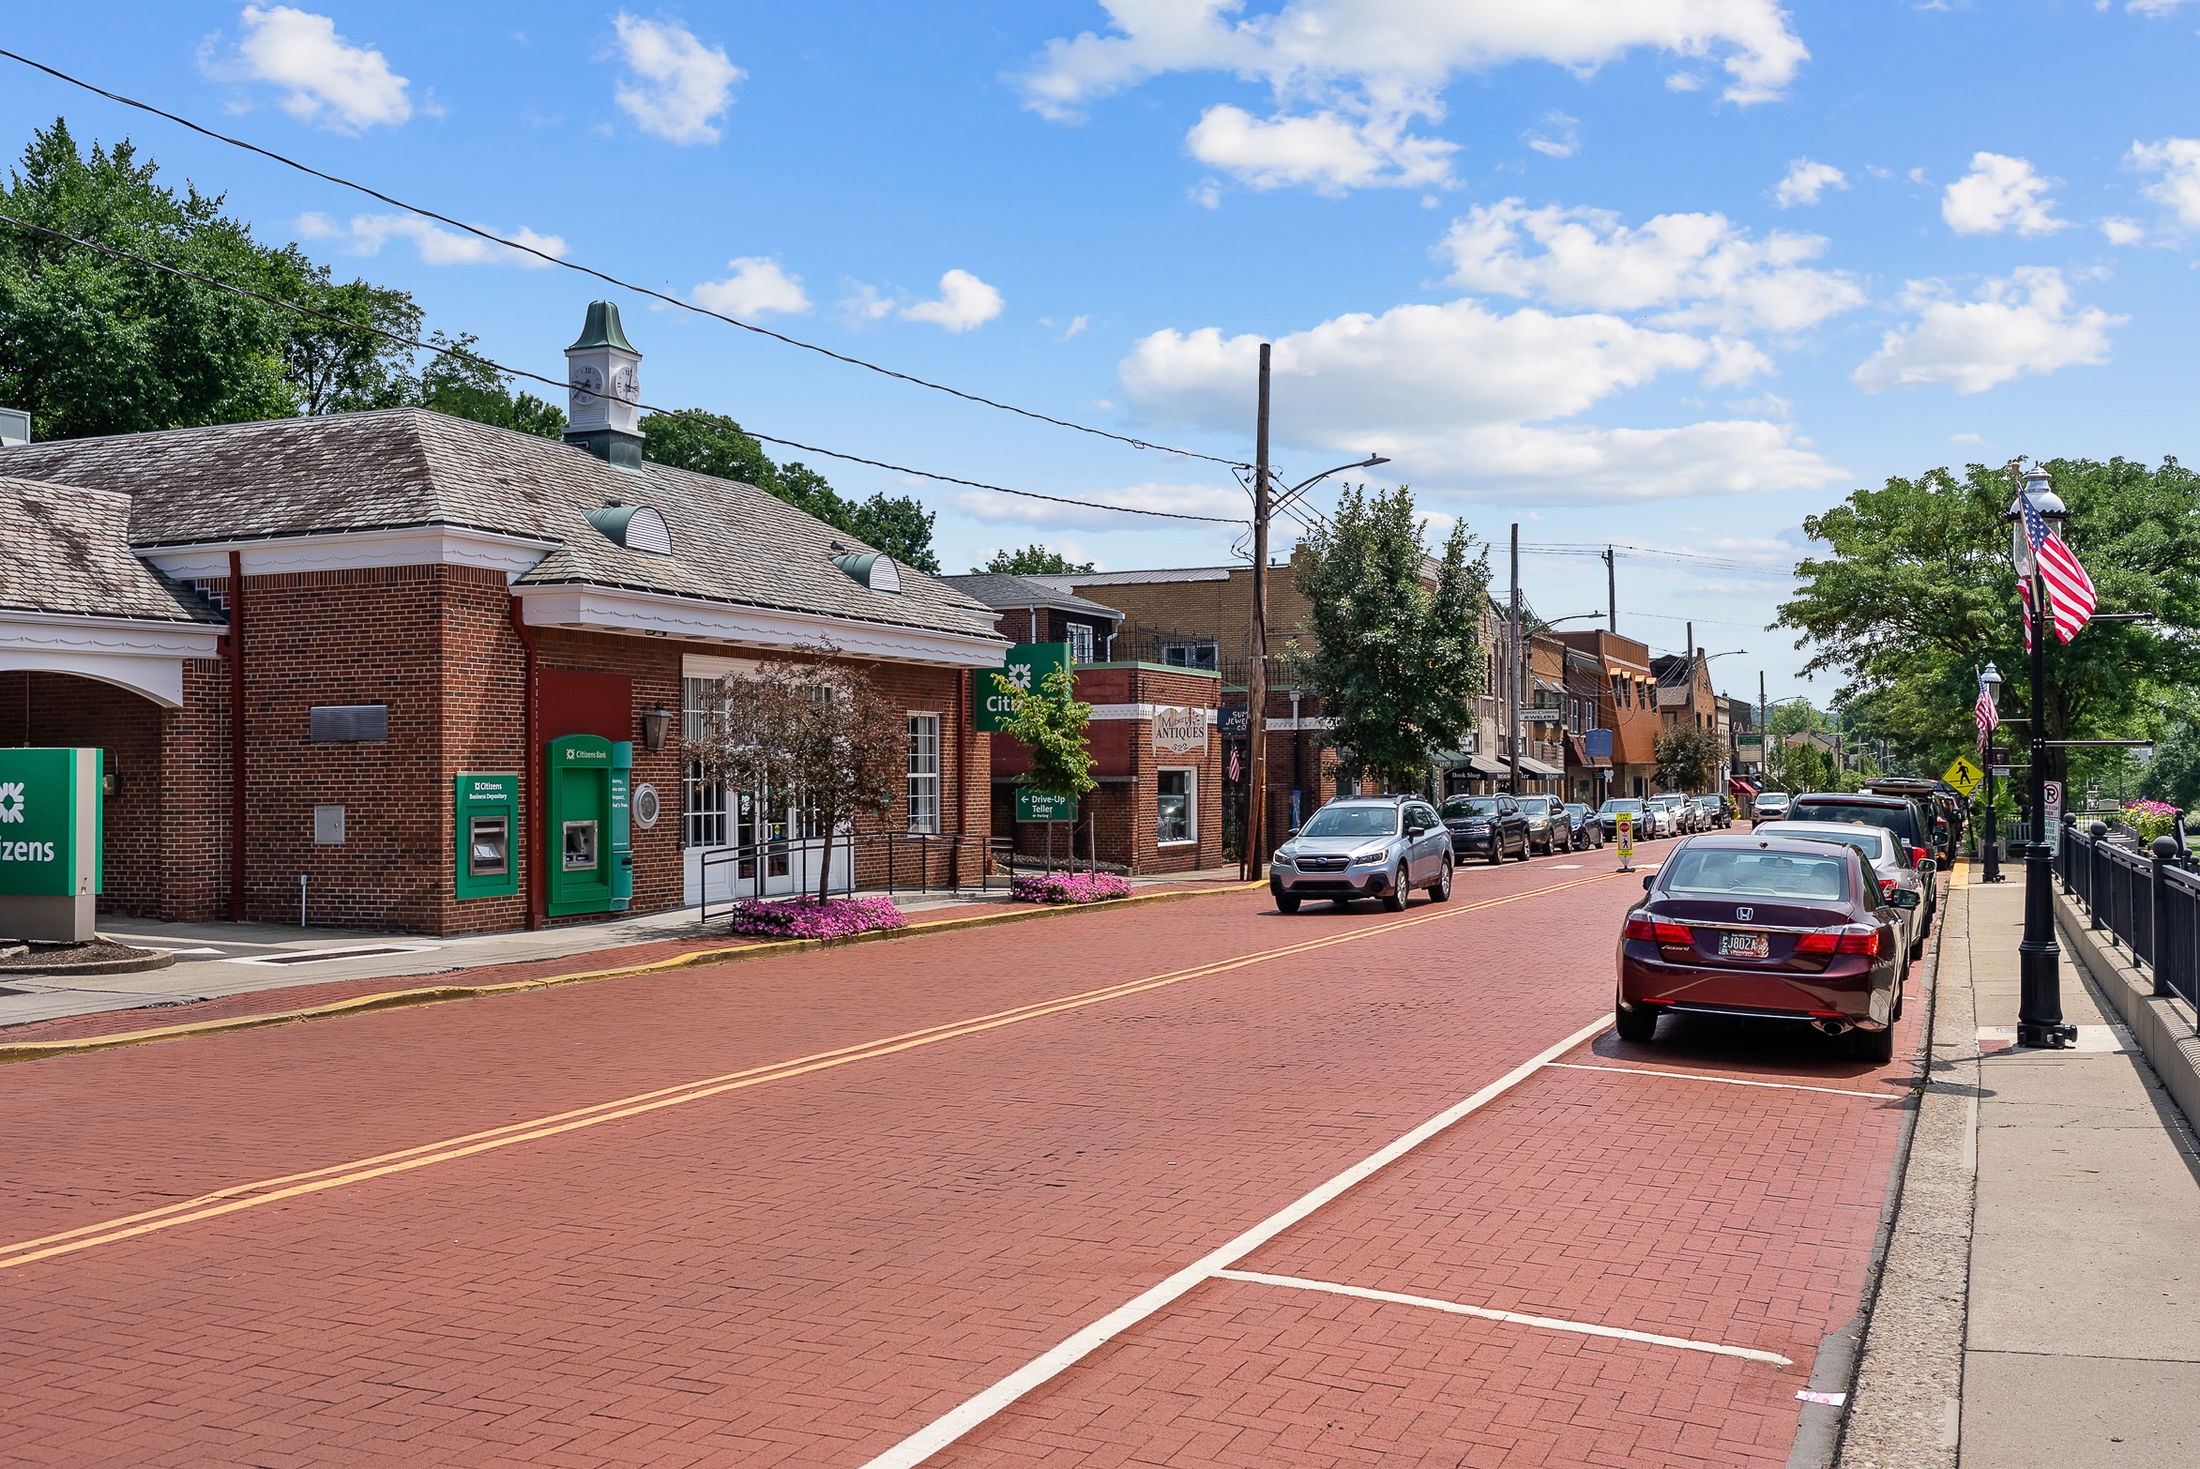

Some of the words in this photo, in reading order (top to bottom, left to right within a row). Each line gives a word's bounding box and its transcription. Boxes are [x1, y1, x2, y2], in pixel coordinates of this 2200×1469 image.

[1155, 726, 1205, 740] ANTIQUES
[576, 750, 596, 758] Citizens
[1467, 772, 1481, 780] Shop
[480, 782, 502, 790] Citizens
[1031, 795, 1066, 805] Drive-Up
